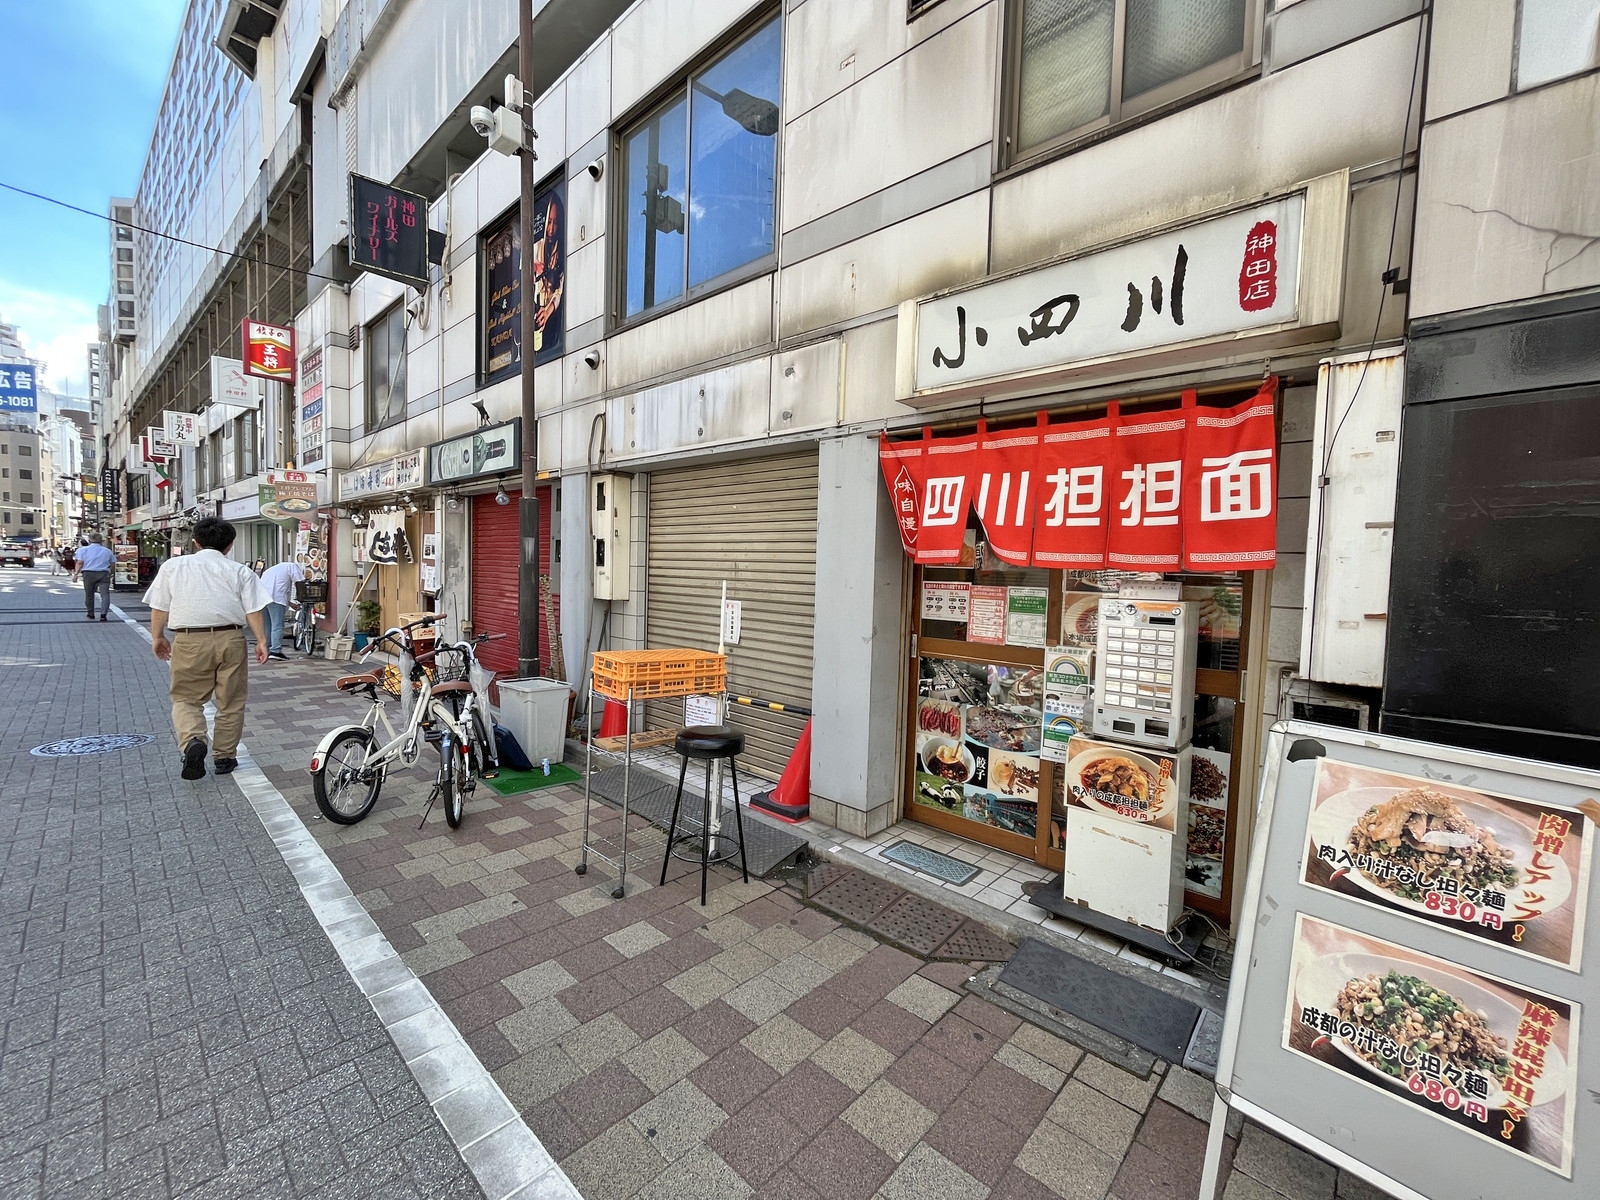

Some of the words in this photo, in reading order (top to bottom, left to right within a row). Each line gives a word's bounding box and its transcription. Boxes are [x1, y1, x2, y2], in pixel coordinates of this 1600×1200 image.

[367, 201, 380, 261] ワイナリー
[384, 195, 398, 243] ガールズ
[402, 199, 416, 228] 神田
[1243, 233, 1275, 302] 神田店
[256, 325, 285, 338] 餃子の
[932, 243, 1189, 370] 小四川
[263, 343, 279, 369] 王将
[897, 478, 919, 531] 味自慢
[922, 447, 1274, 528] 四川担担面
[976, 755, 986, 781] 餃子
[1317, 844, 1507, 912] 肉入り汁なし坦々麺
[1510, 812, 1572, 942] 肉増しアップ！
[1300, 1005, 1490, 1101] 成都の汁なし坦々麺
